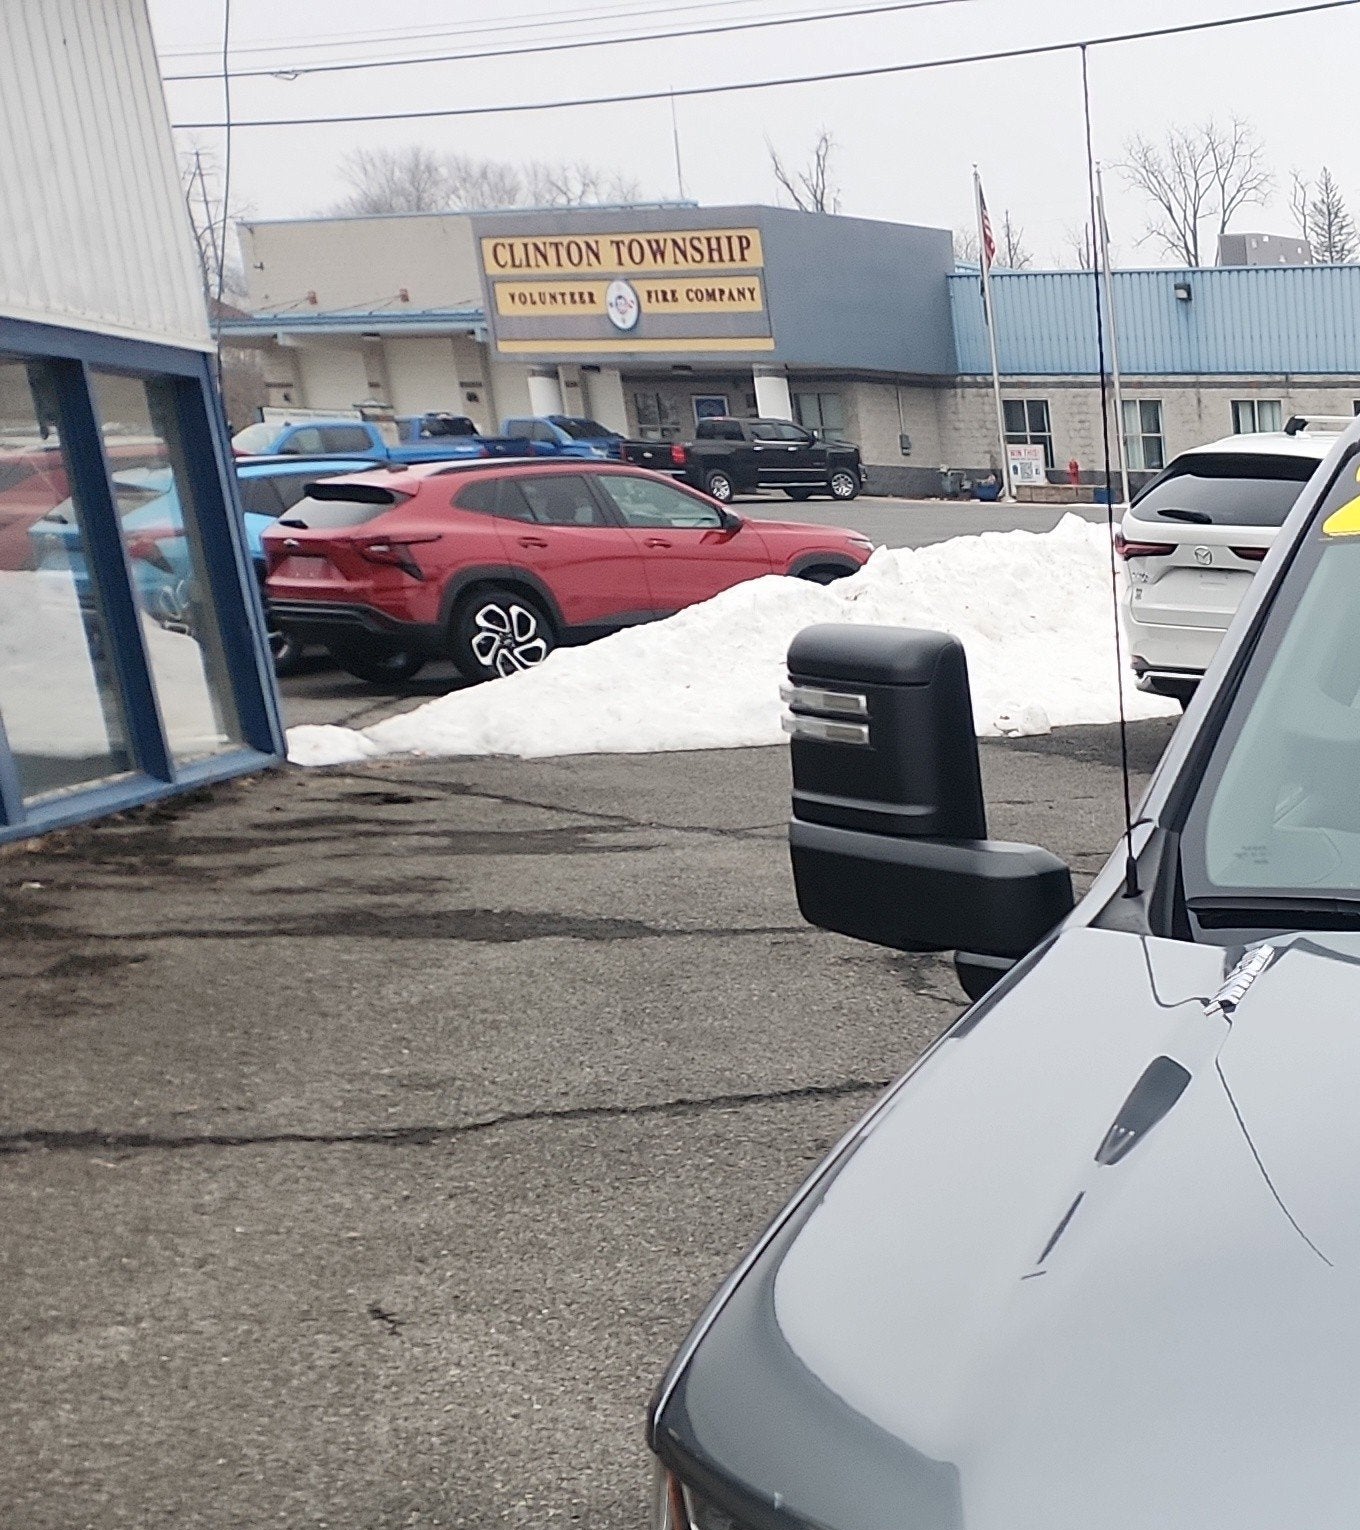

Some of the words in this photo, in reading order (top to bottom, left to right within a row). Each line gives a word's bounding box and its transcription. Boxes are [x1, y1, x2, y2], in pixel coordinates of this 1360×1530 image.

[492, 239, 602, 268] CLINTON
[610, 235, 751, 266] TOWNSHIP
[508, 291, 597, 306] VOLUNTEER
[646, 289, 678, 304] FIRE
[685, 287, 756, 302] COMPANY
